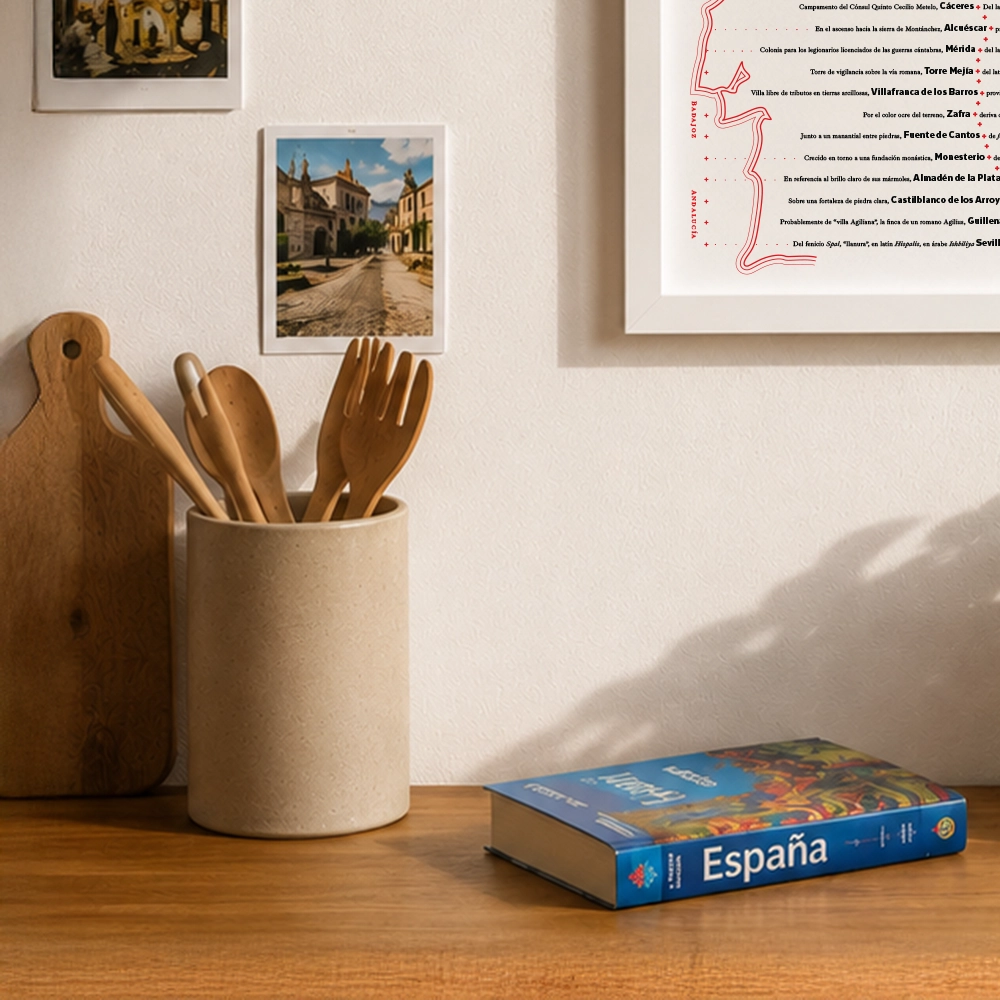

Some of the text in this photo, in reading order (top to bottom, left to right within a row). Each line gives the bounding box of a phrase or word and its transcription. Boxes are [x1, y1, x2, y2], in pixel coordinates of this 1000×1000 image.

[939, 1, 974, 10] Cáceres
[944, 23, 987, 32] Alcuéscar
[945, 44, 976, 53] Mérida
[924, 66, 974, 76] Torre Mejía
[871, 87, 978, 96] Villafranca de los Barros
[946, 109, 971, 118] Zafra
[690, 101, 698, 139] BADAJOZ
[904, 130, 980, 139] Fuente de Cantos
[935, 152, 985, 161] Monesterio
[913, 173, 953, 182] Almadén
[954, 173, 966, 182] de
[967, 173, 976, 182] la
[891, 195, 946, 204] Castilblanco
[948, 195, 959, 204] de
[960, 195, 974, 204] los
[703, 832, 828, 884] España
